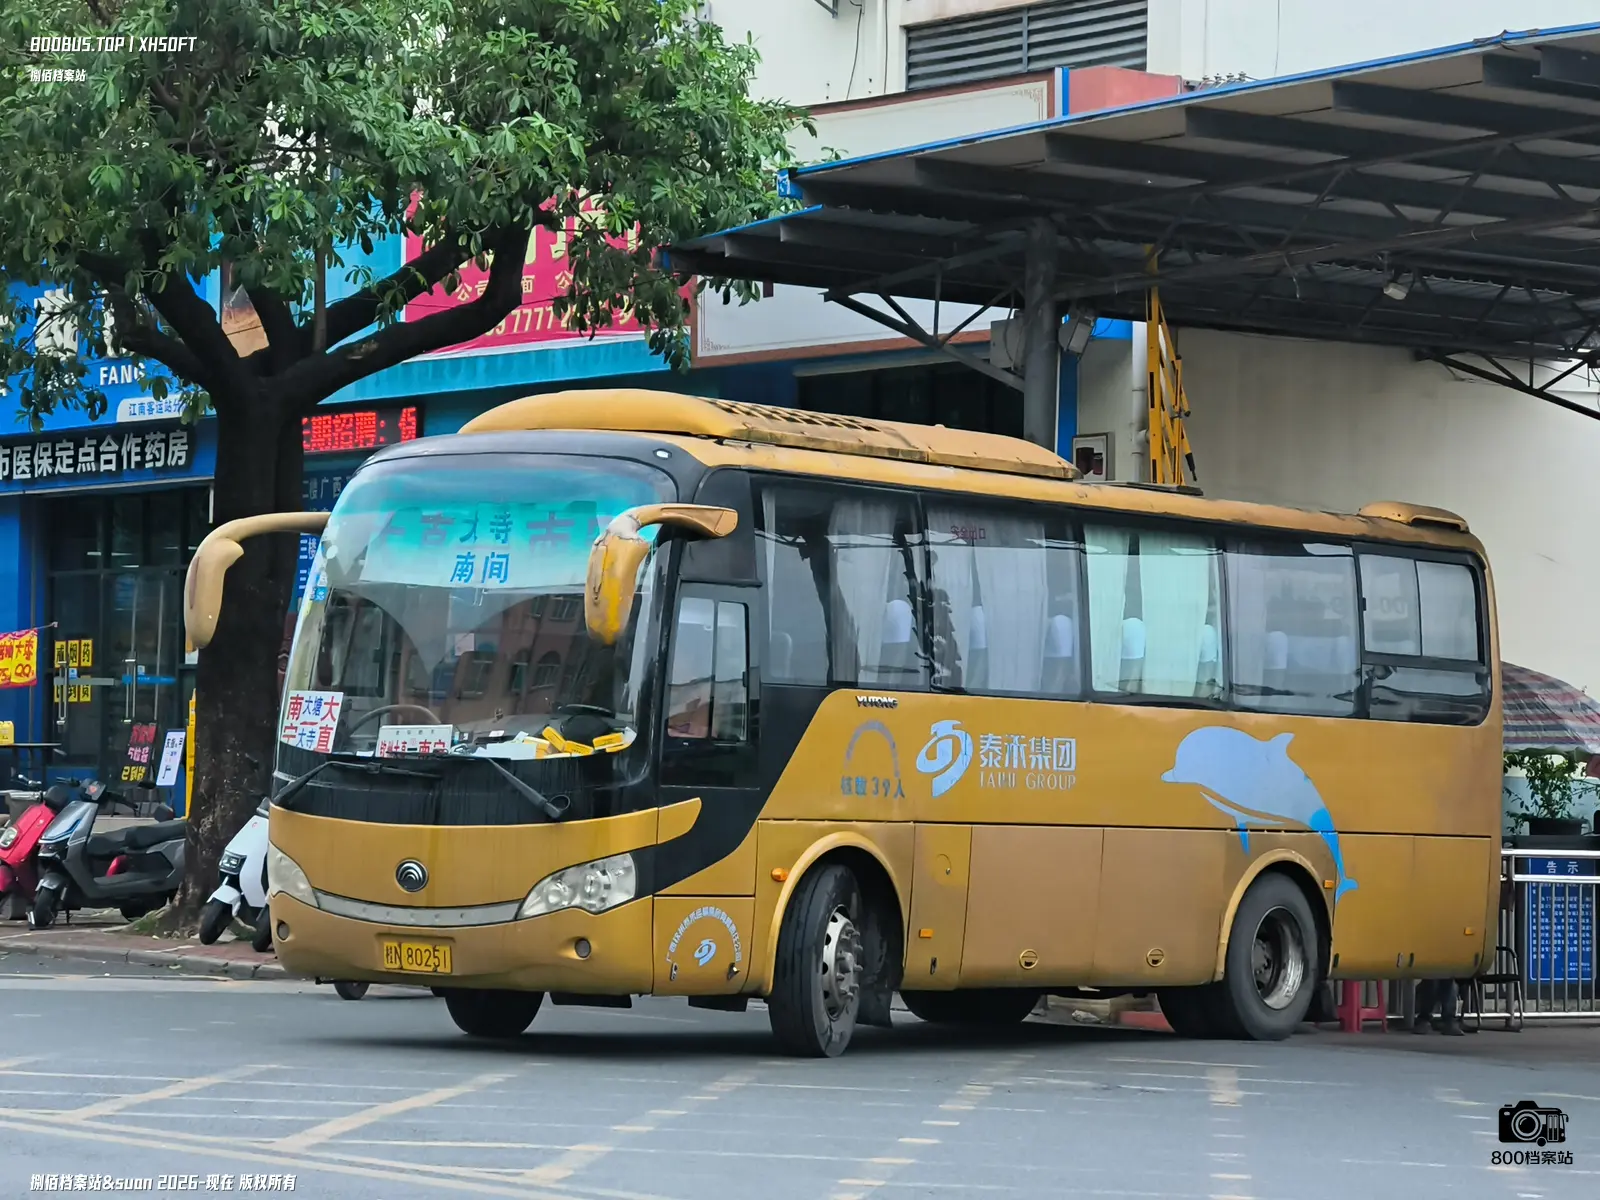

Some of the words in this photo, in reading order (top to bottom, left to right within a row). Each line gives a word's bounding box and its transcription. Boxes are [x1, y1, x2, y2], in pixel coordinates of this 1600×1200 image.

[100, 363, 146, 386] FANG
[449, 551, 511, 584] 南间
[1025, 772, 1076, 790] GROUP
[1546, 861, 1579, 874] 告示
